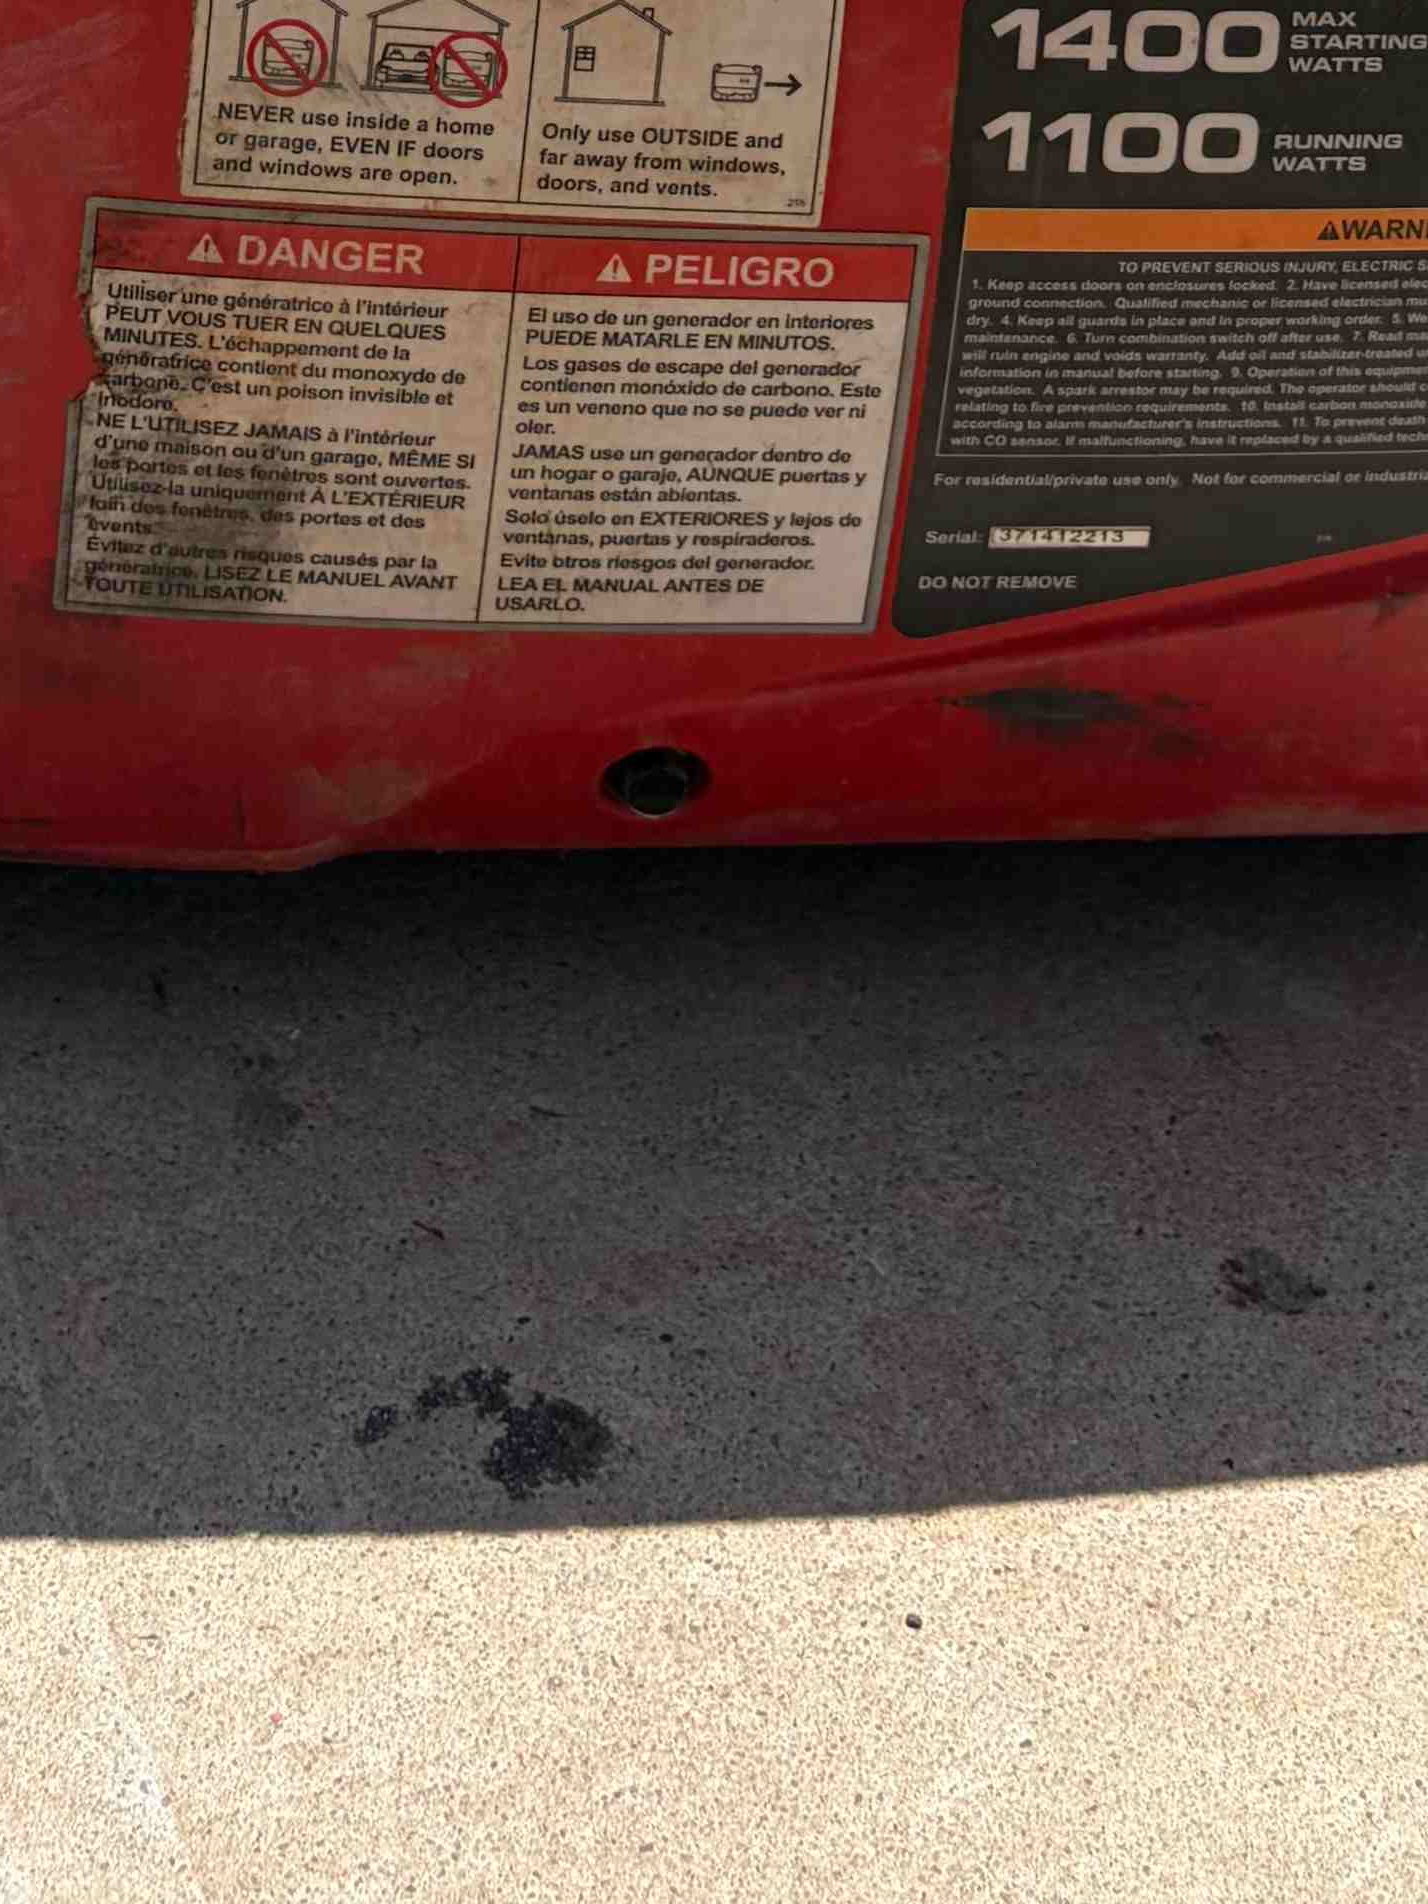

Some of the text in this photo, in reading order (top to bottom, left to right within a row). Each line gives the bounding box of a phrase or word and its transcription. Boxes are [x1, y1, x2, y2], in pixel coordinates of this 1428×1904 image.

[990, 7, 1356, 73] 1400 MAX
[1289, 33, 1428, 51] STARTING
[1288, 56, 1384, 73] WATTS
[217, 101, 495, 136] NEVER use inside a home
[214, 131, 484, 160] or garage, EVEN IF doors
[542, 122, 784, 149] Only use OUTSIDE and
[981, 111, 1404, 174] 1100 RUNNING
[212, 153, 458, 190] and windows are open.
[539, 147, 786, 179] far away from windows,
[1272, 155, 1367, 172] WATTS
[536, 171, 718, 197] doors, and vents.
[237, 235, 425, 275] DANGER
[1118, 262, 1139, 274] TO
[1141, 261, 1212, 274] PREVENT
[1214, 261, 1282, 273] SERIOUS
[1341, 259, 1415, 272] ELECTRIC
[645, 253, 835, 287] PELIGRO
[105, 305, 446, 341] PEUT VOUS TUER EN QUELQUES
[527, 308, 875, 332] El uso de un generador en interiores
[525, 329, 835, 351] PUEDE MATARLE EN MINUTOS.
[522, 355, 861, 381] Los gases de escape del generador
[589, 449, 625, 461] use
[629, 450, 655, 461] un
[659, 446, 758, 467] generador
[761, 448, 824, 464] dentro
[827, 449, 852, 464] de
[497, 577, 764, 593] LEA EL MANUAL ANTES DE
[918, 576, 1078, 589] DO NOT REMOVE
